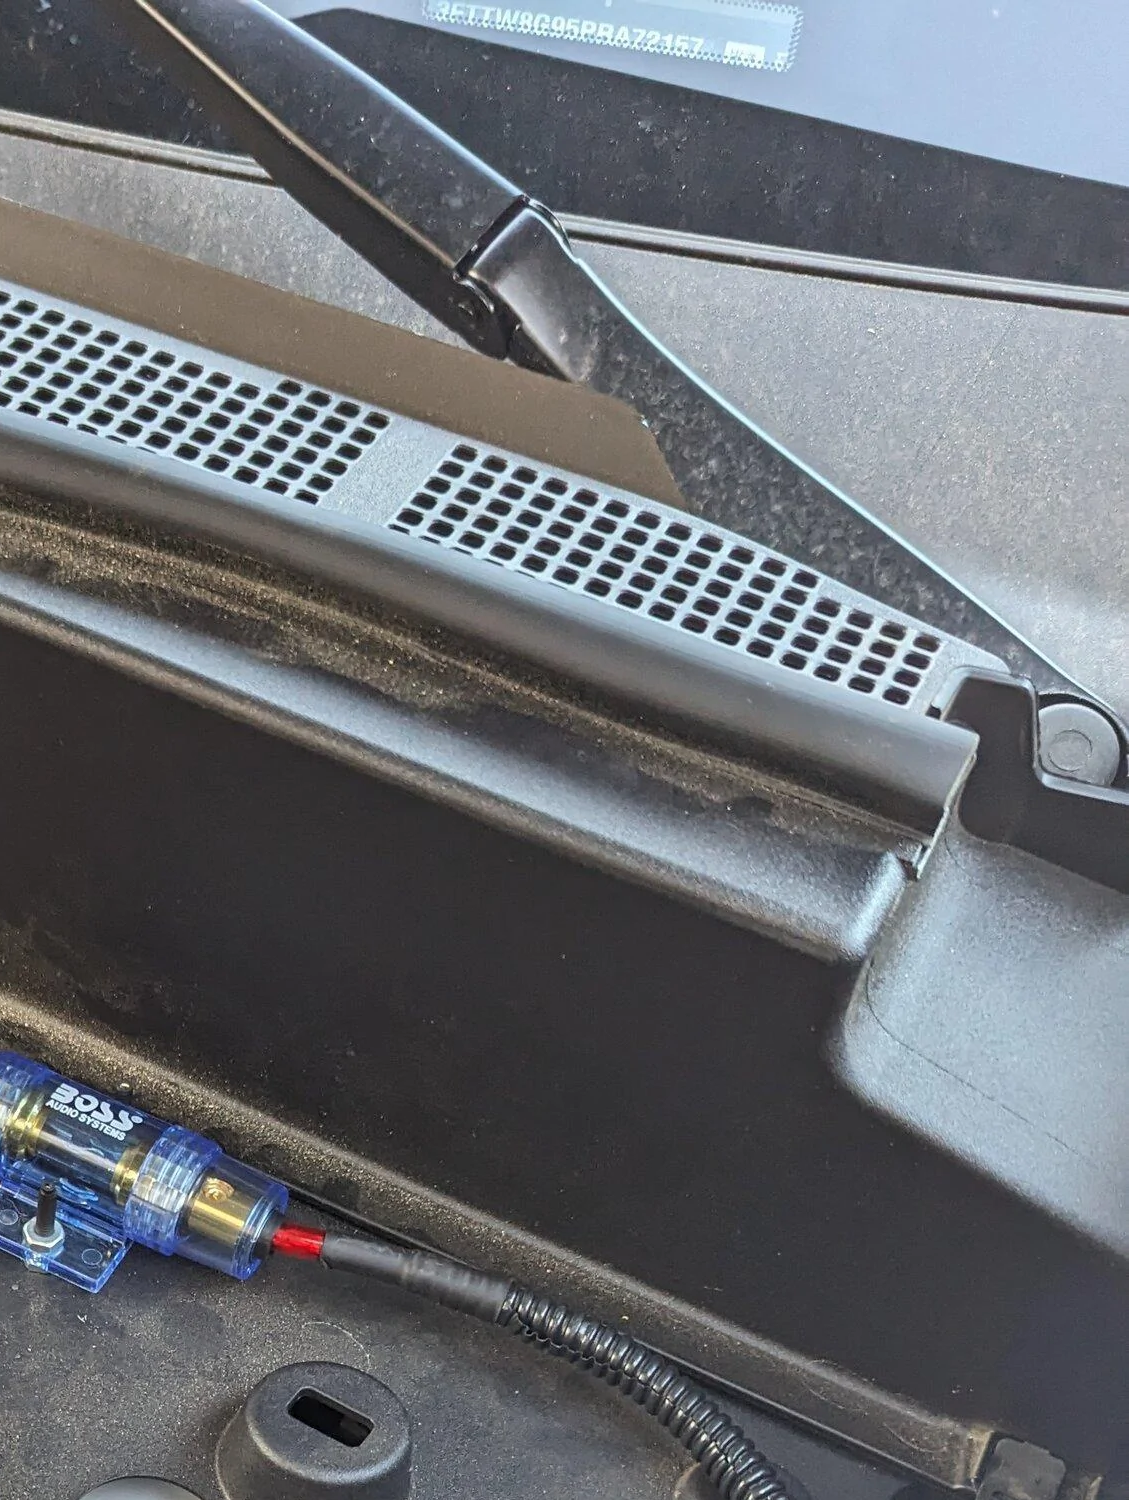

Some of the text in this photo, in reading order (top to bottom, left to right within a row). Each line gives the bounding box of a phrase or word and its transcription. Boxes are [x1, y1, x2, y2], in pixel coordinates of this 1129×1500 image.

[45, 1100, 127, 1141] AUDIO SYSTEMS
[51, 1083, 135, 1132] BOSS
